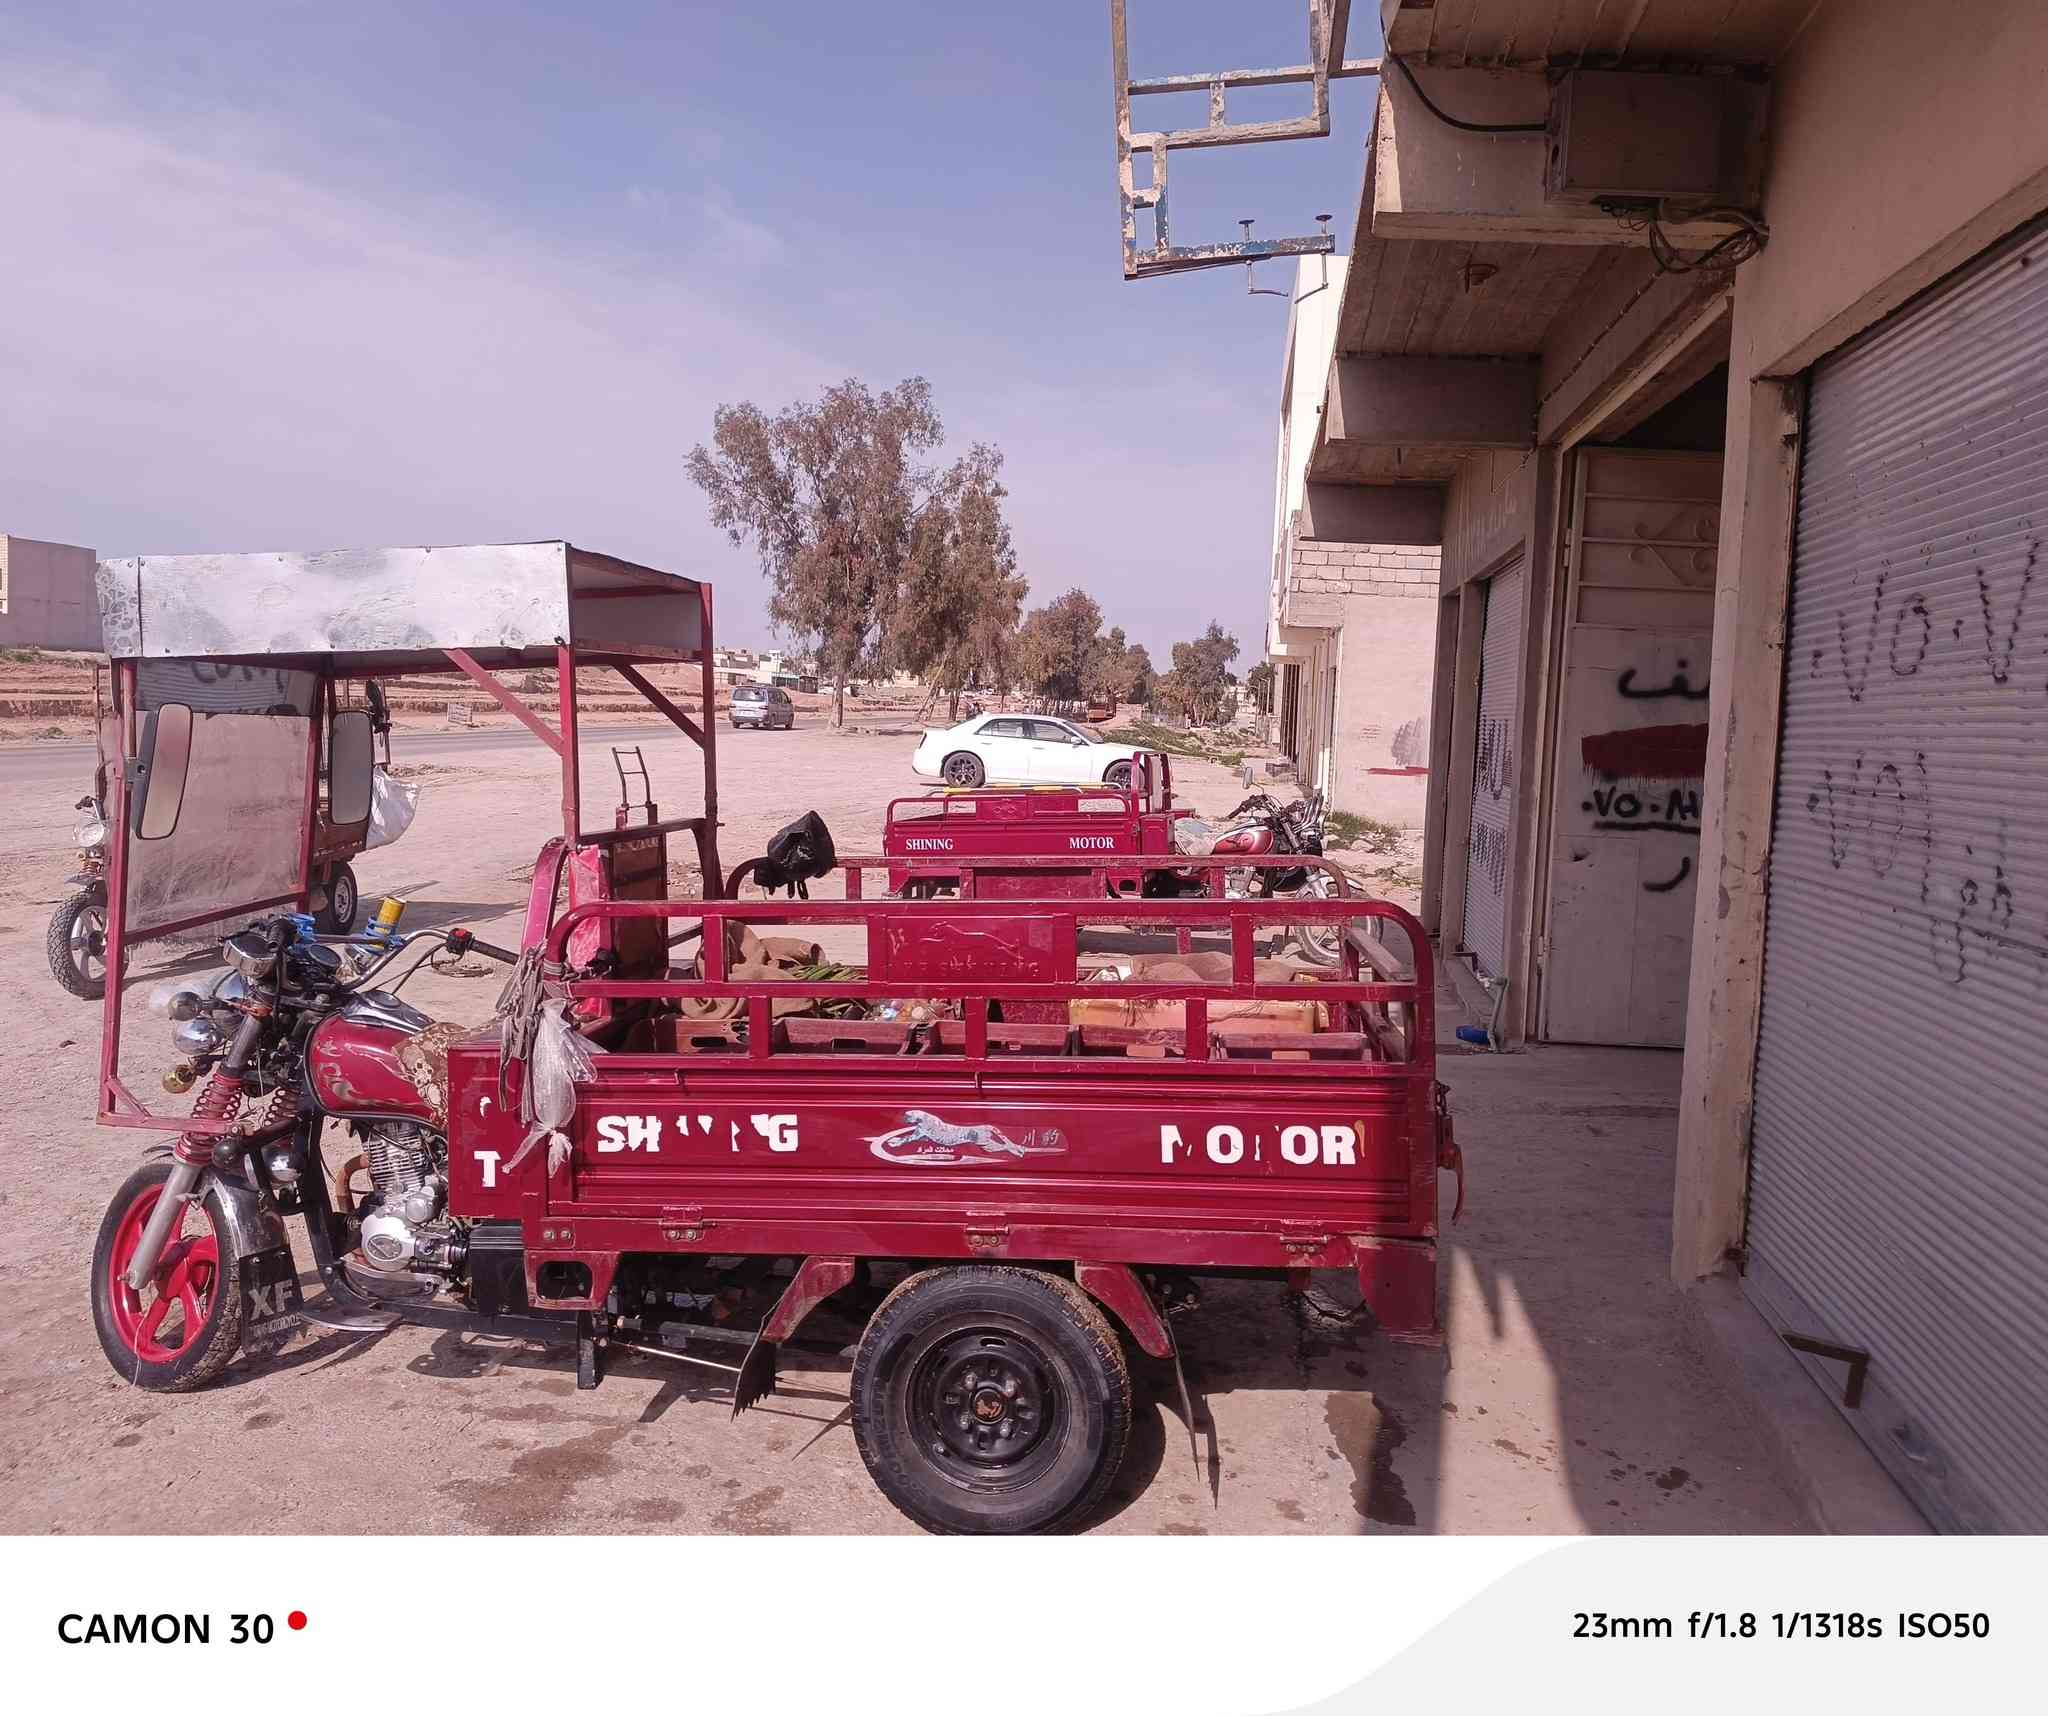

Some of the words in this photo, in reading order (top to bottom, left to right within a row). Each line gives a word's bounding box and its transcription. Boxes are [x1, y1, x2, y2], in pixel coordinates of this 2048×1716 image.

[906, 838, 953, 850] SHINING
[1069, 836, 1115, 849] MOTOR
[248, 1279, 294, 1321] XF
